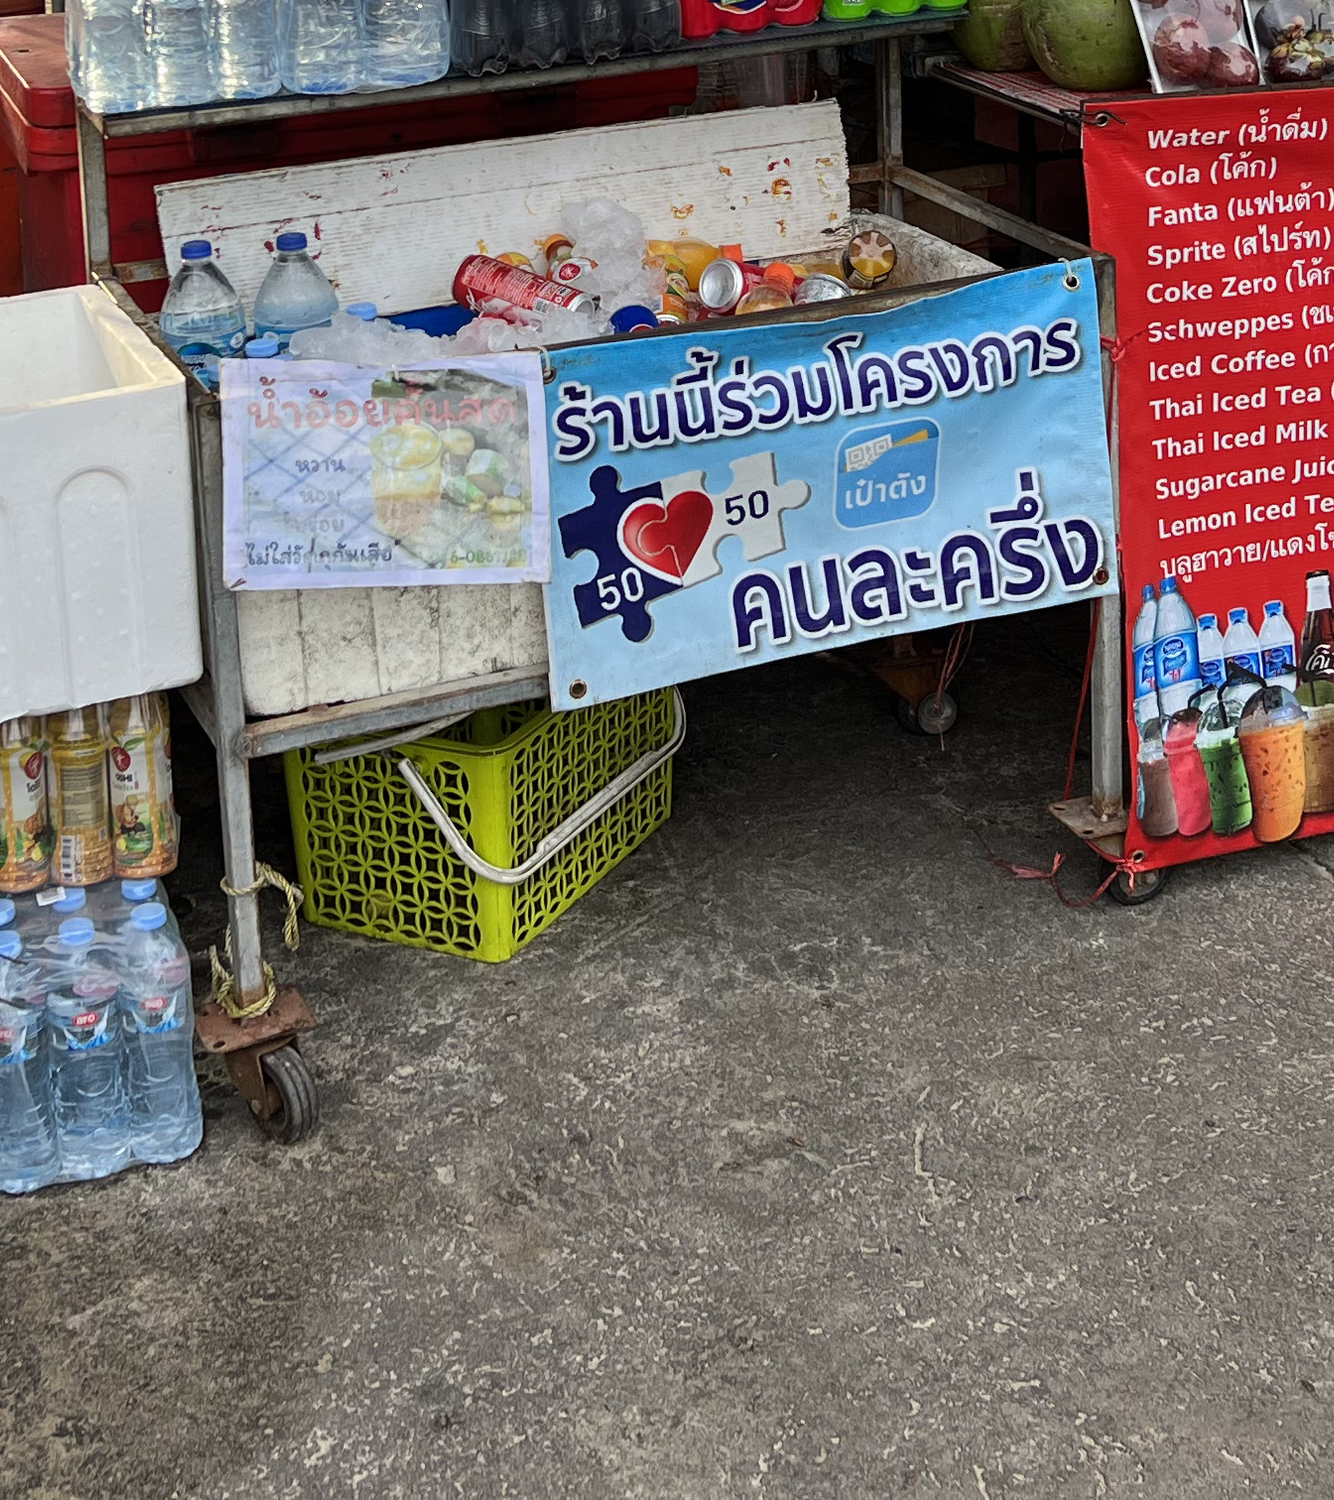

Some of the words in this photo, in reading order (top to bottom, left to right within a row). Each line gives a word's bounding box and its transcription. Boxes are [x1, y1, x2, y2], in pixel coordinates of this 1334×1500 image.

[1147, 128, 1231, 150] Water
[1238, 106, 1328, 147] (น้ำดื่ม)
[1144, 163, 1200, 188] Cola
[1210, 150, 1277, 185] (โค้ก)
[1148, 202, 1219, 227] Fanta
[1147, 240, 1226, 270] Sprite
[1233, 220, 1332, 260] (สไปร์ท)
[1146, 280, 1213, 304] Coke
[1221, 275, 1277, 298] Zero
[1147, 312, 1294, 343] Schweppes
[1149, 355, 1202, 382] Iced
[1210, 349, 1296, 374] Coffee
[556, 322, 1080, 458] ร้านนี้ร่วมโครงการ
[1148, 393, 1203, 421] Thai
[1212, 387, 1267, 413] Iced
[1274, 384, 1322, 406] Tea
[1151, 432, 1204, 460] Thai
[1213, 424, 1266, 451] Iced
[1275, 418, 1329, 444] Milk
[844, 471, 927, 510] เป๋าตัง
[1155, 465, 1286, 500] Sugarcane
[725, 488, 770, 526] 50
[1158, 510, 1237, 540] Lemon
[1245, 496, 1296, 524] Iced
[733, 469, 1103, 650] คนละครึ่ง
[598, 567, 644, 607] 50
